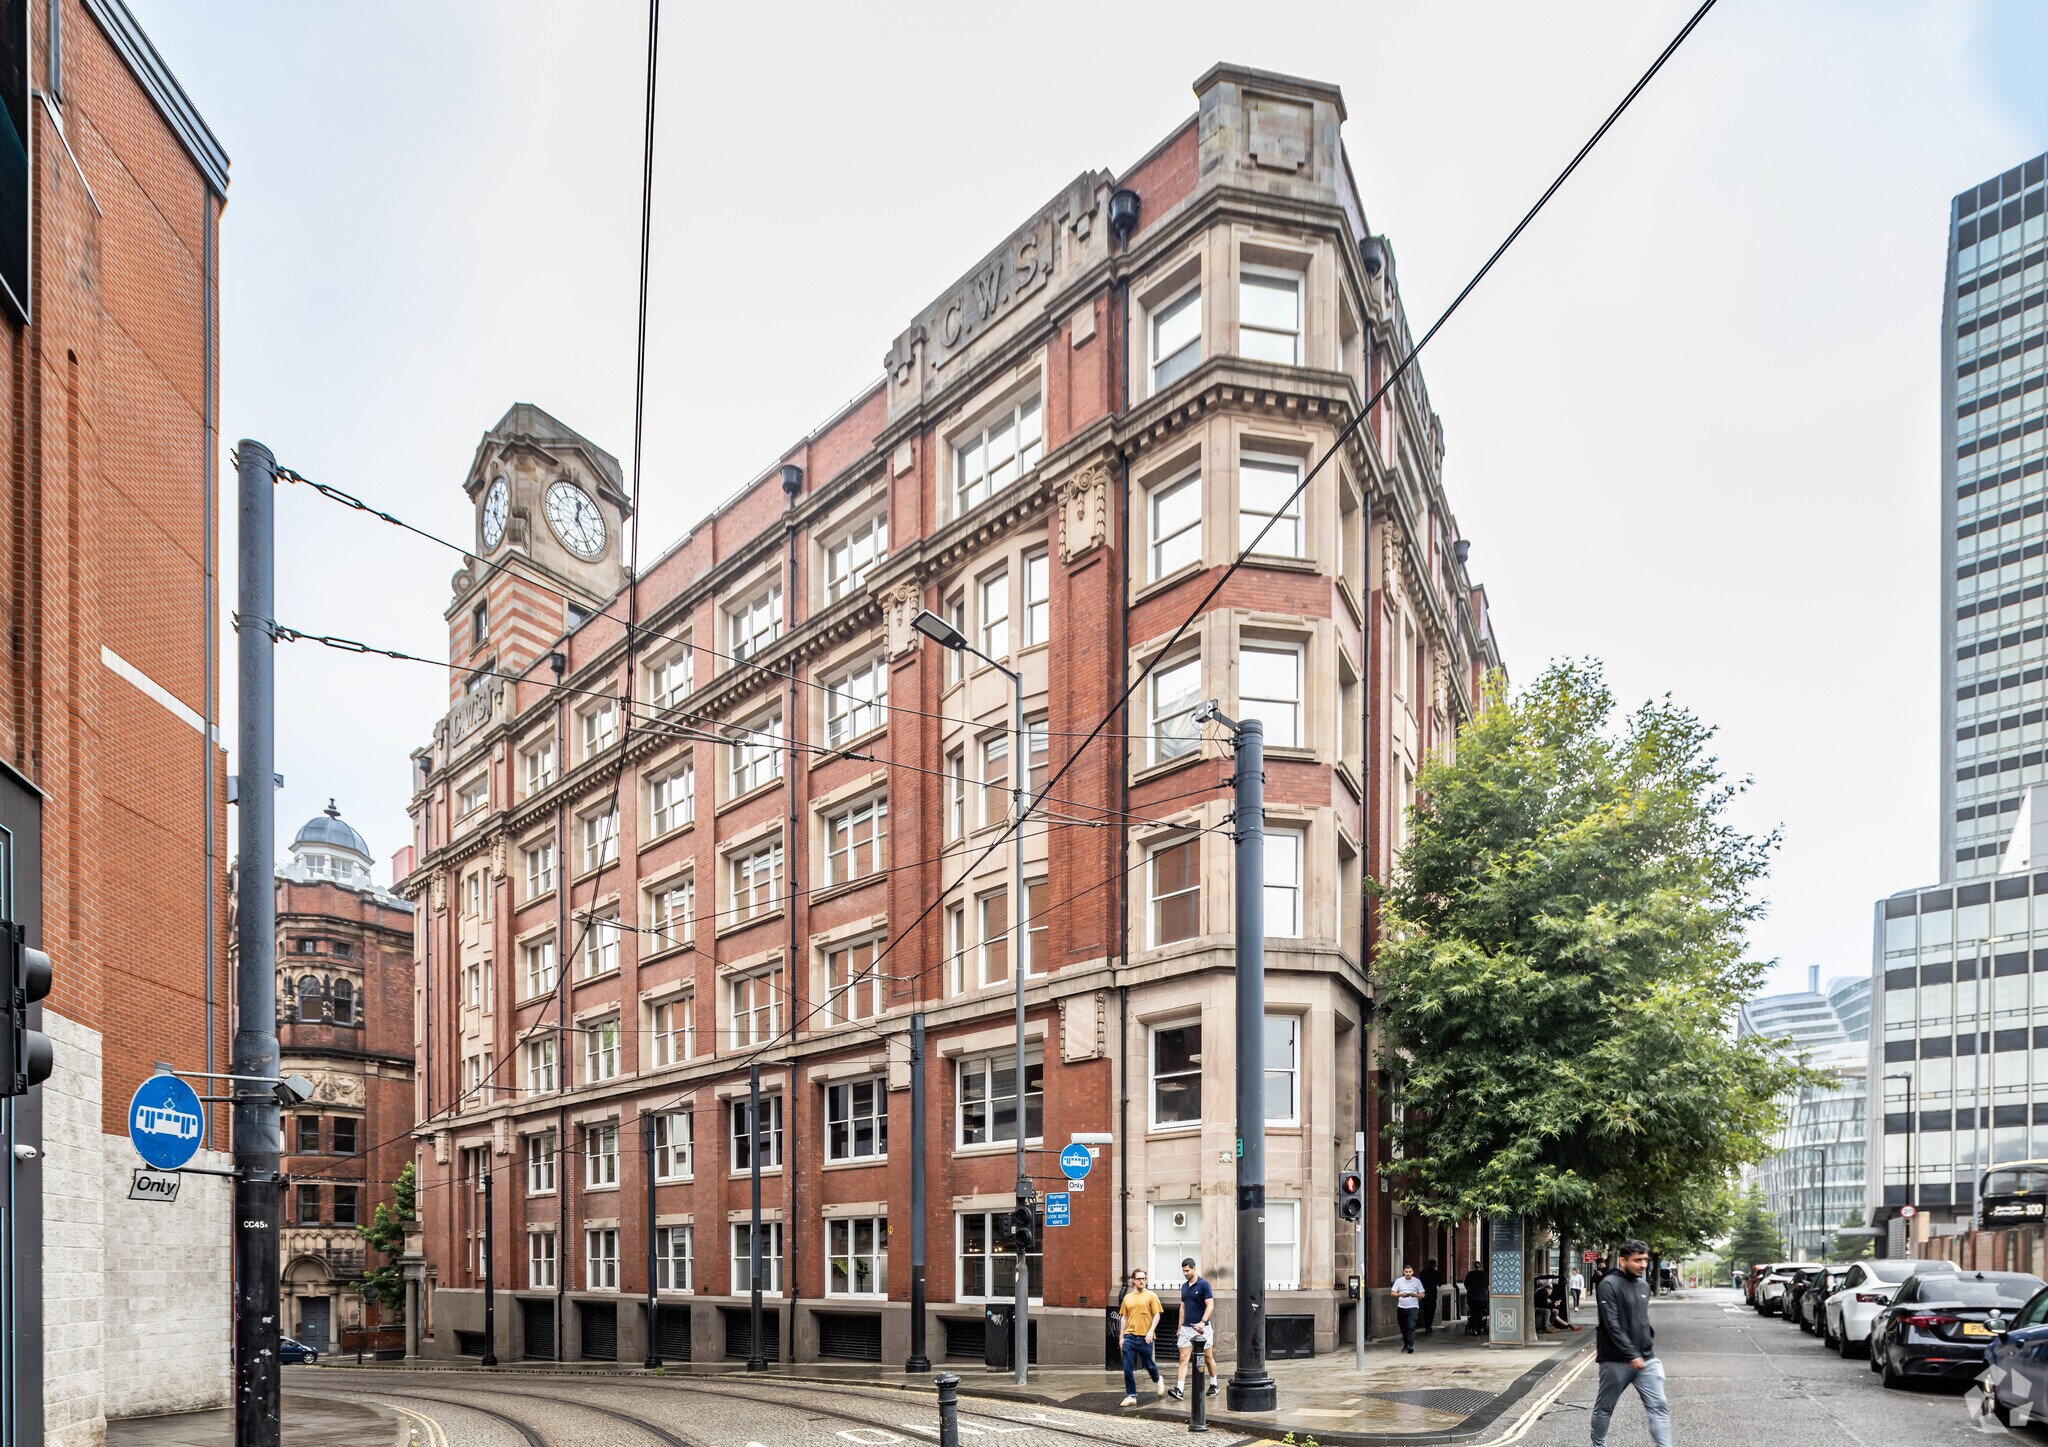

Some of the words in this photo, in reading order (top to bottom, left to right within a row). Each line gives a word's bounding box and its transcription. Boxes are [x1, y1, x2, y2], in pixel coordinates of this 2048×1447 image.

[941, 232, 1048, 349] C.W.S.
[453, 690, 490, 739] C.W.S.
[137, 1176, 176, 1195] Only
[1069, 1182, 1083, 1190] Only
